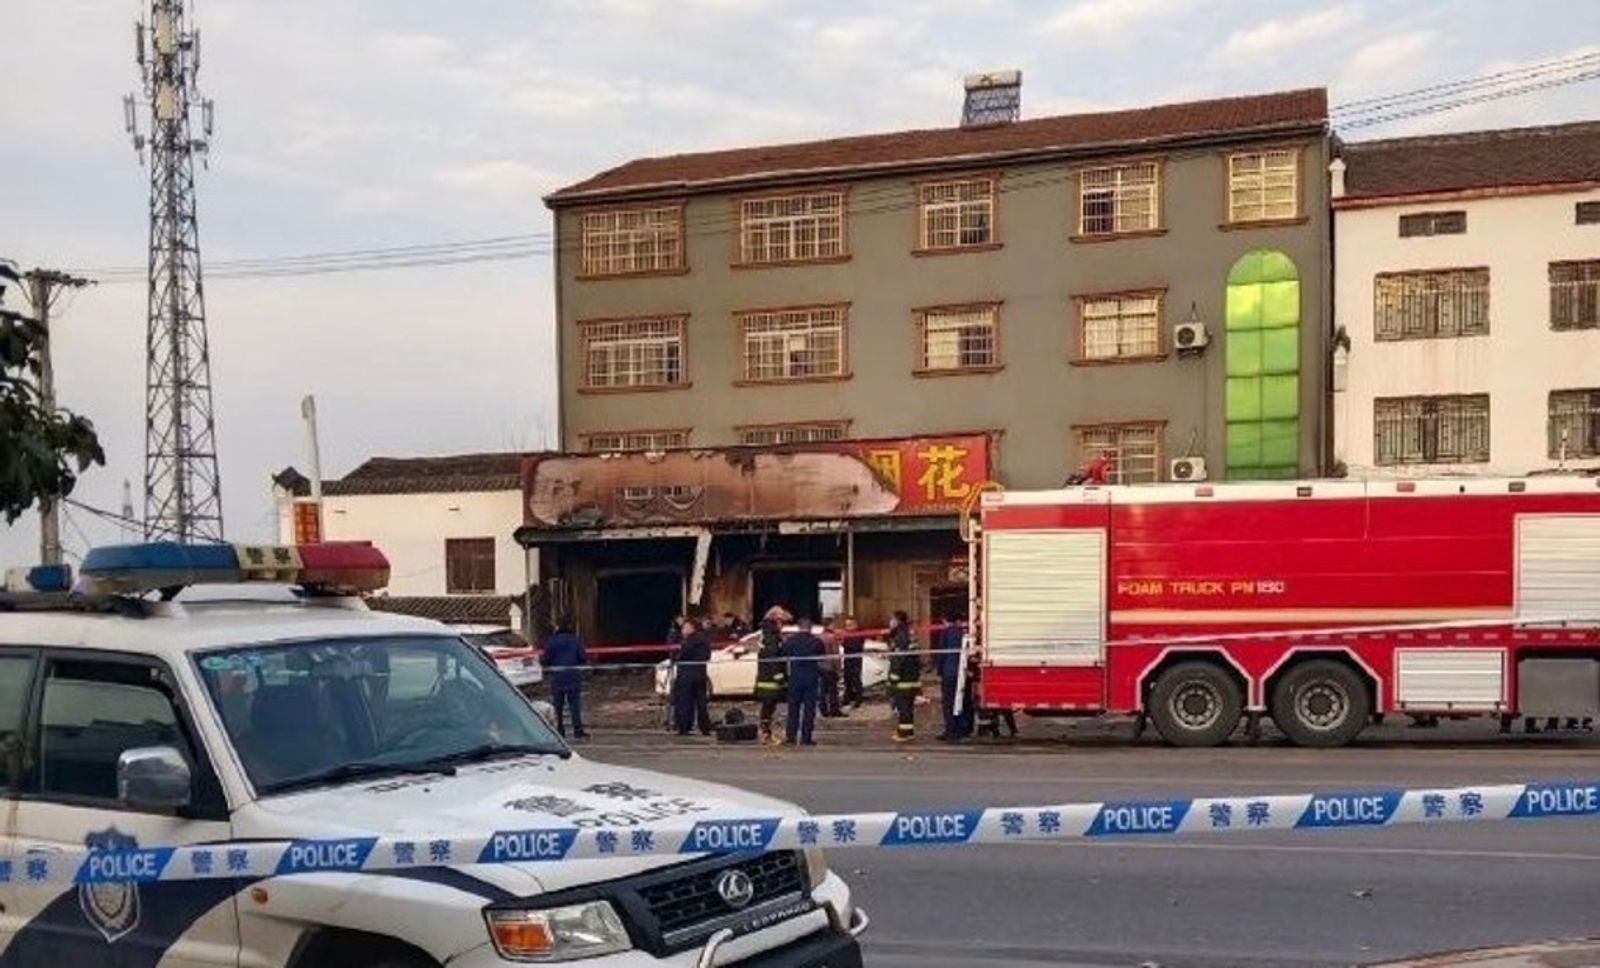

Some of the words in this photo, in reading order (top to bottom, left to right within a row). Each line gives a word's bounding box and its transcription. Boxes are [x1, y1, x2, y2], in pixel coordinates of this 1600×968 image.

[1117, 581, 1163, 595] FOAM
[1169, 582, 1225, 594] TRUCK
[90, 853, 157, 878] POLICE
[191, 849, 249, 874] 警察
[291, 844, 358, 868] POLICE
[394, 839, 450, 864] 警察
[494, 833, 561, 858] POLICE
[596, 829, 654, 853] 警察
[696, 824, 763, 848] POLICE
[797, 819, 856, 844] 警察
[899, 814, 966, 839] POLICE
[1001, 810, 1060, 835] 警察
[1104, 806, 1173, 830] POLICE
[1209, 802, 1270, 827] 警察
[1315, 797, 1384, 821] POLICE
[1423, 792, 1483, 817] 警察
[1527, 787, 1597, 812] POLICE
